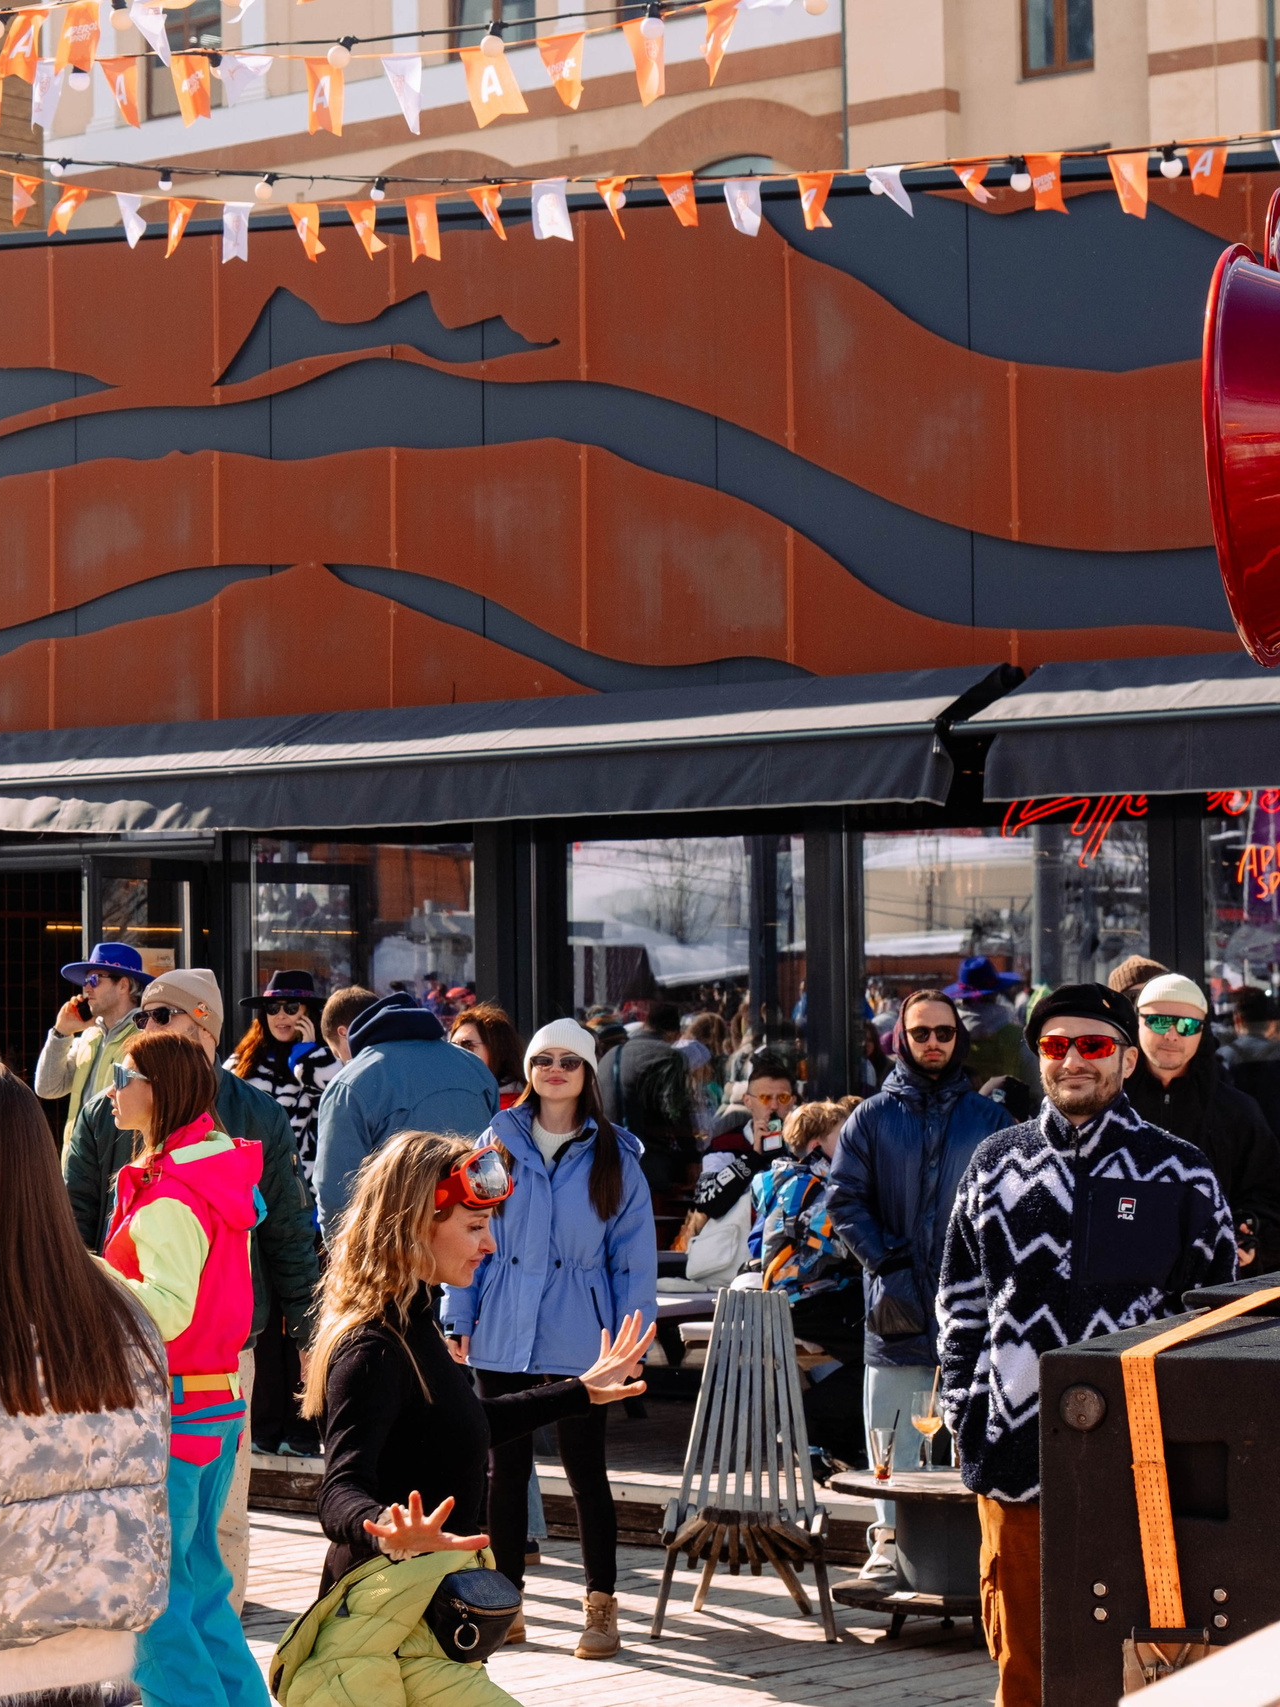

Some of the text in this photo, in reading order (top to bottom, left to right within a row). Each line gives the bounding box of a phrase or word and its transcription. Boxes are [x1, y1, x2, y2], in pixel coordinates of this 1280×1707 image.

[8, 24, 35, 59] A
[115, 74, 129, 106] A
[312, 75, 331, 112] A
[481, 64, 503, 104] A
[1191, 149, 1215, 180] A
[1117, 1213, 1134, 1221] FILA
